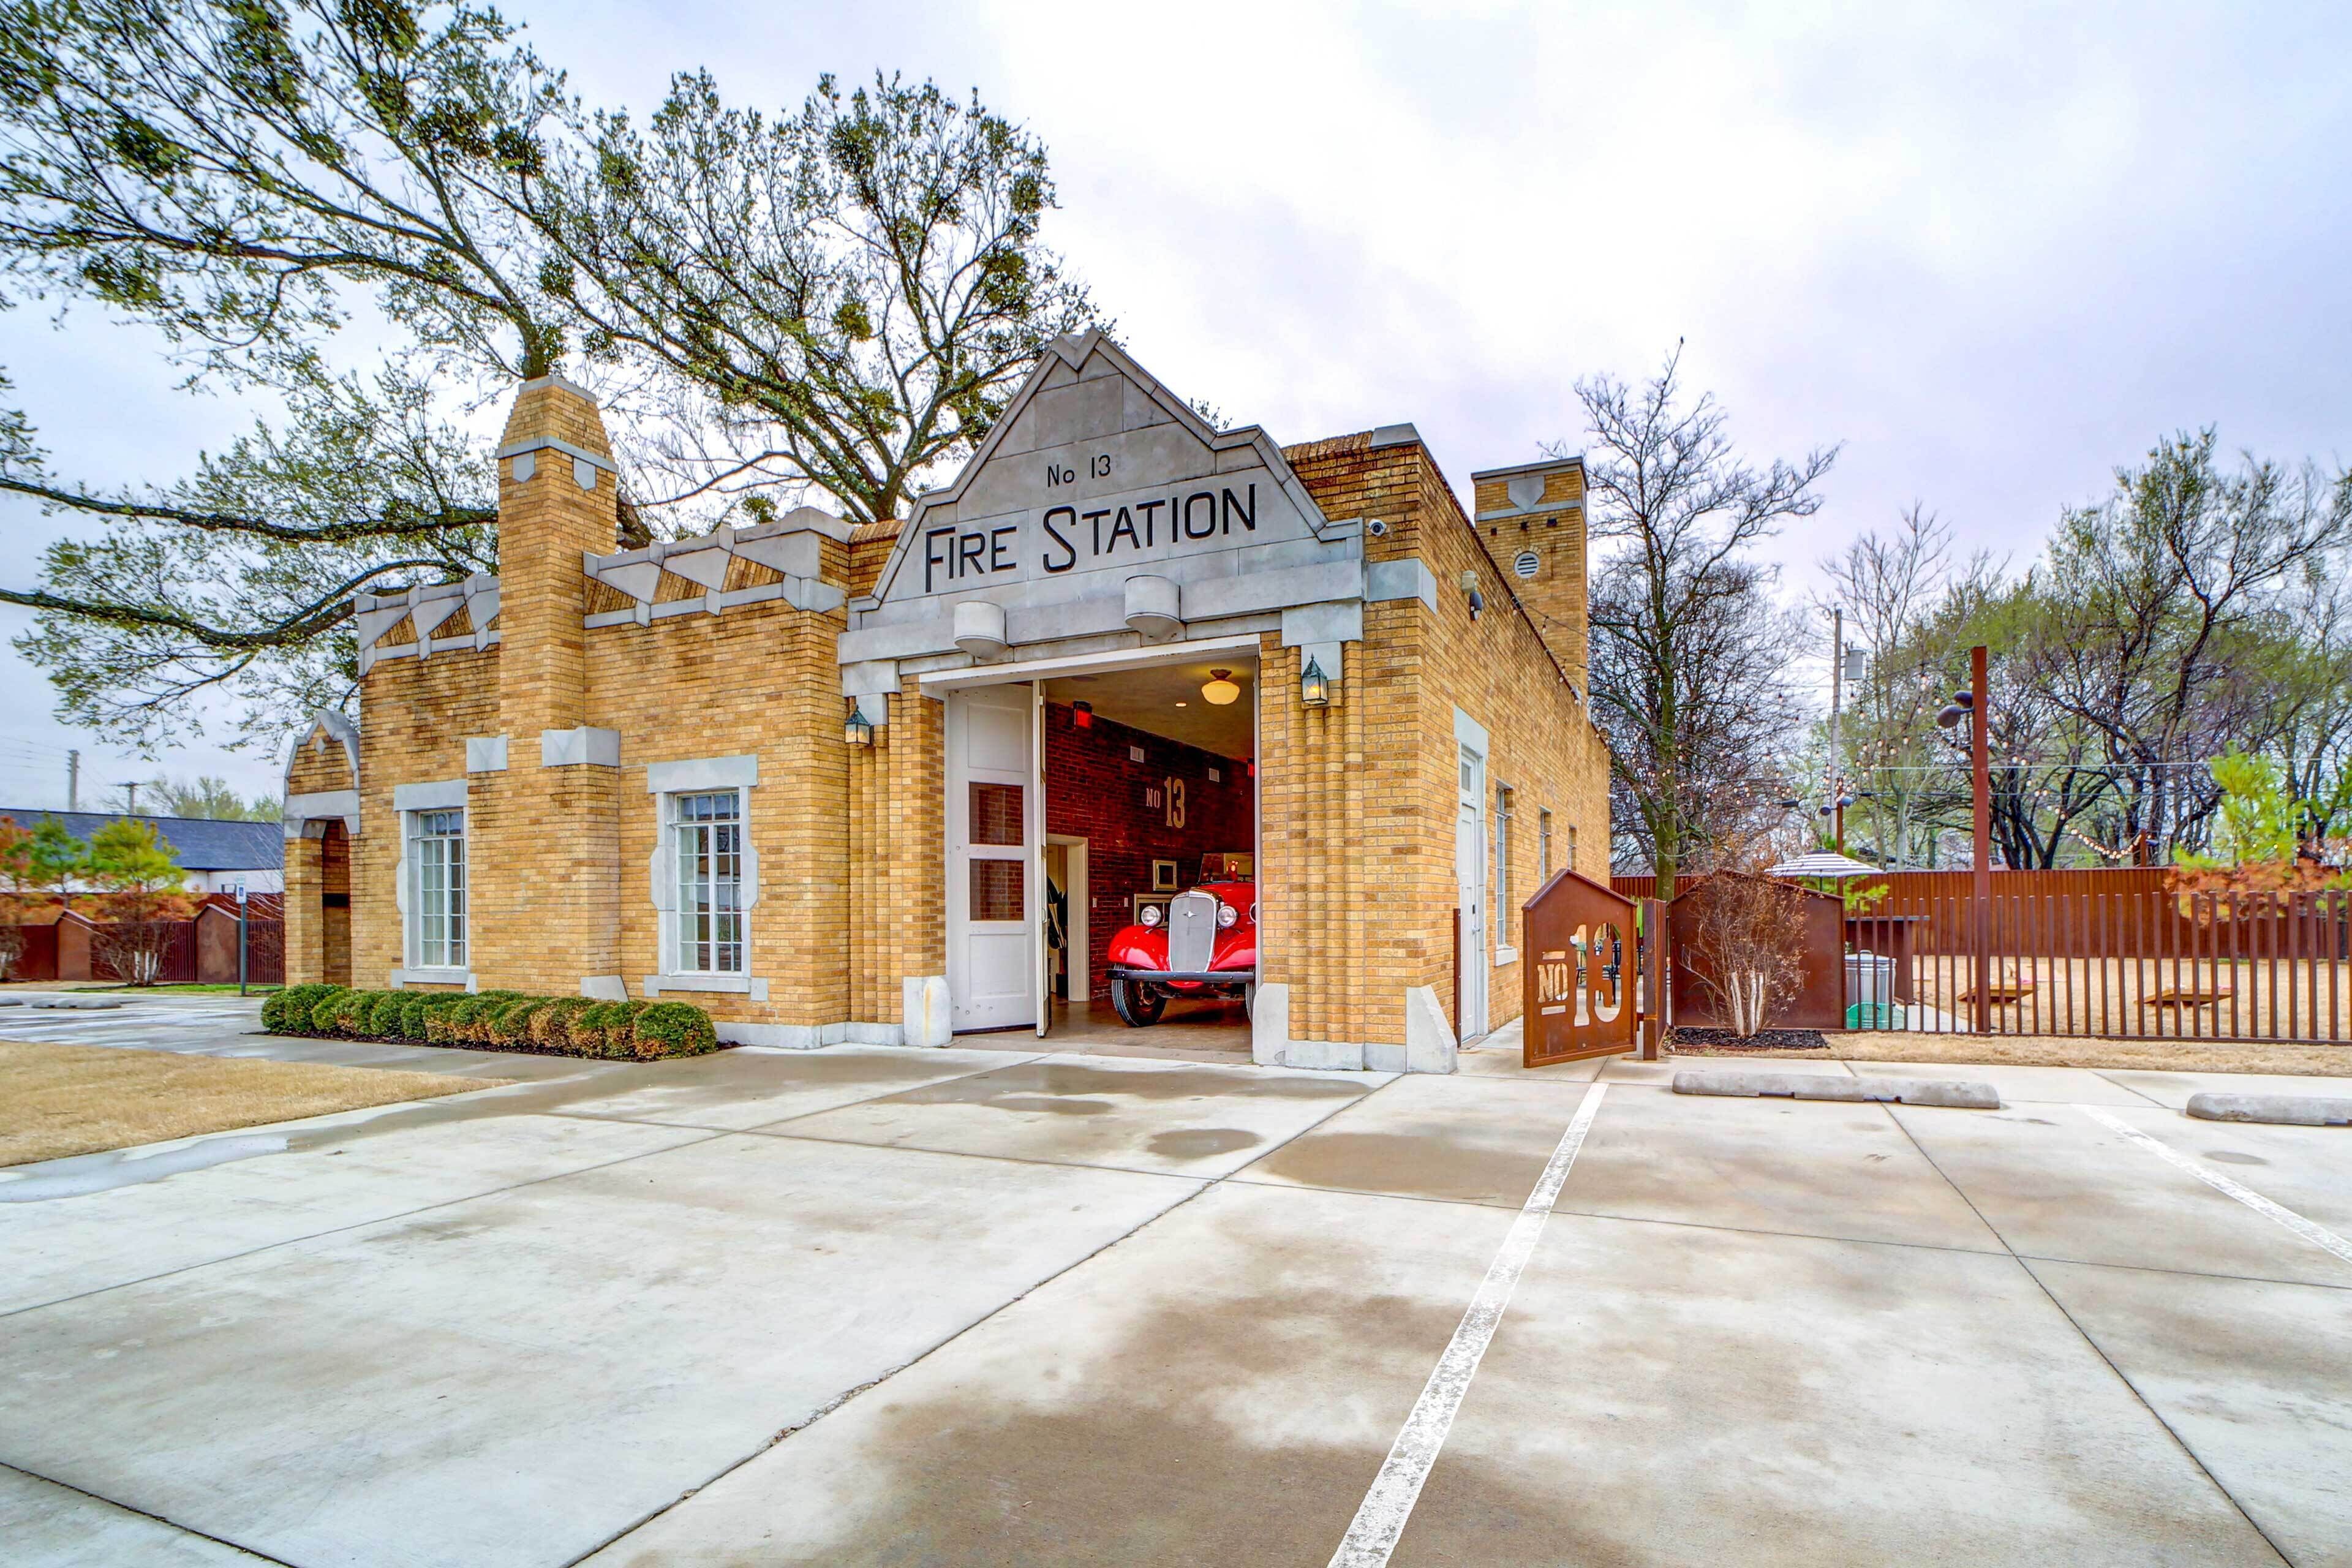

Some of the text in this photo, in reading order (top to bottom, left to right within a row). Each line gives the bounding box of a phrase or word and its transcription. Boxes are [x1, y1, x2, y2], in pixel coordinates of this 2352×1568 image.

[1047, 454, 1112, 488] No 13
[925, 483, 1256, 593] FIRE STATION
[1146, 776, 1185, 828] NO 13
[1537, 922, 1622, 1027] NO 13
